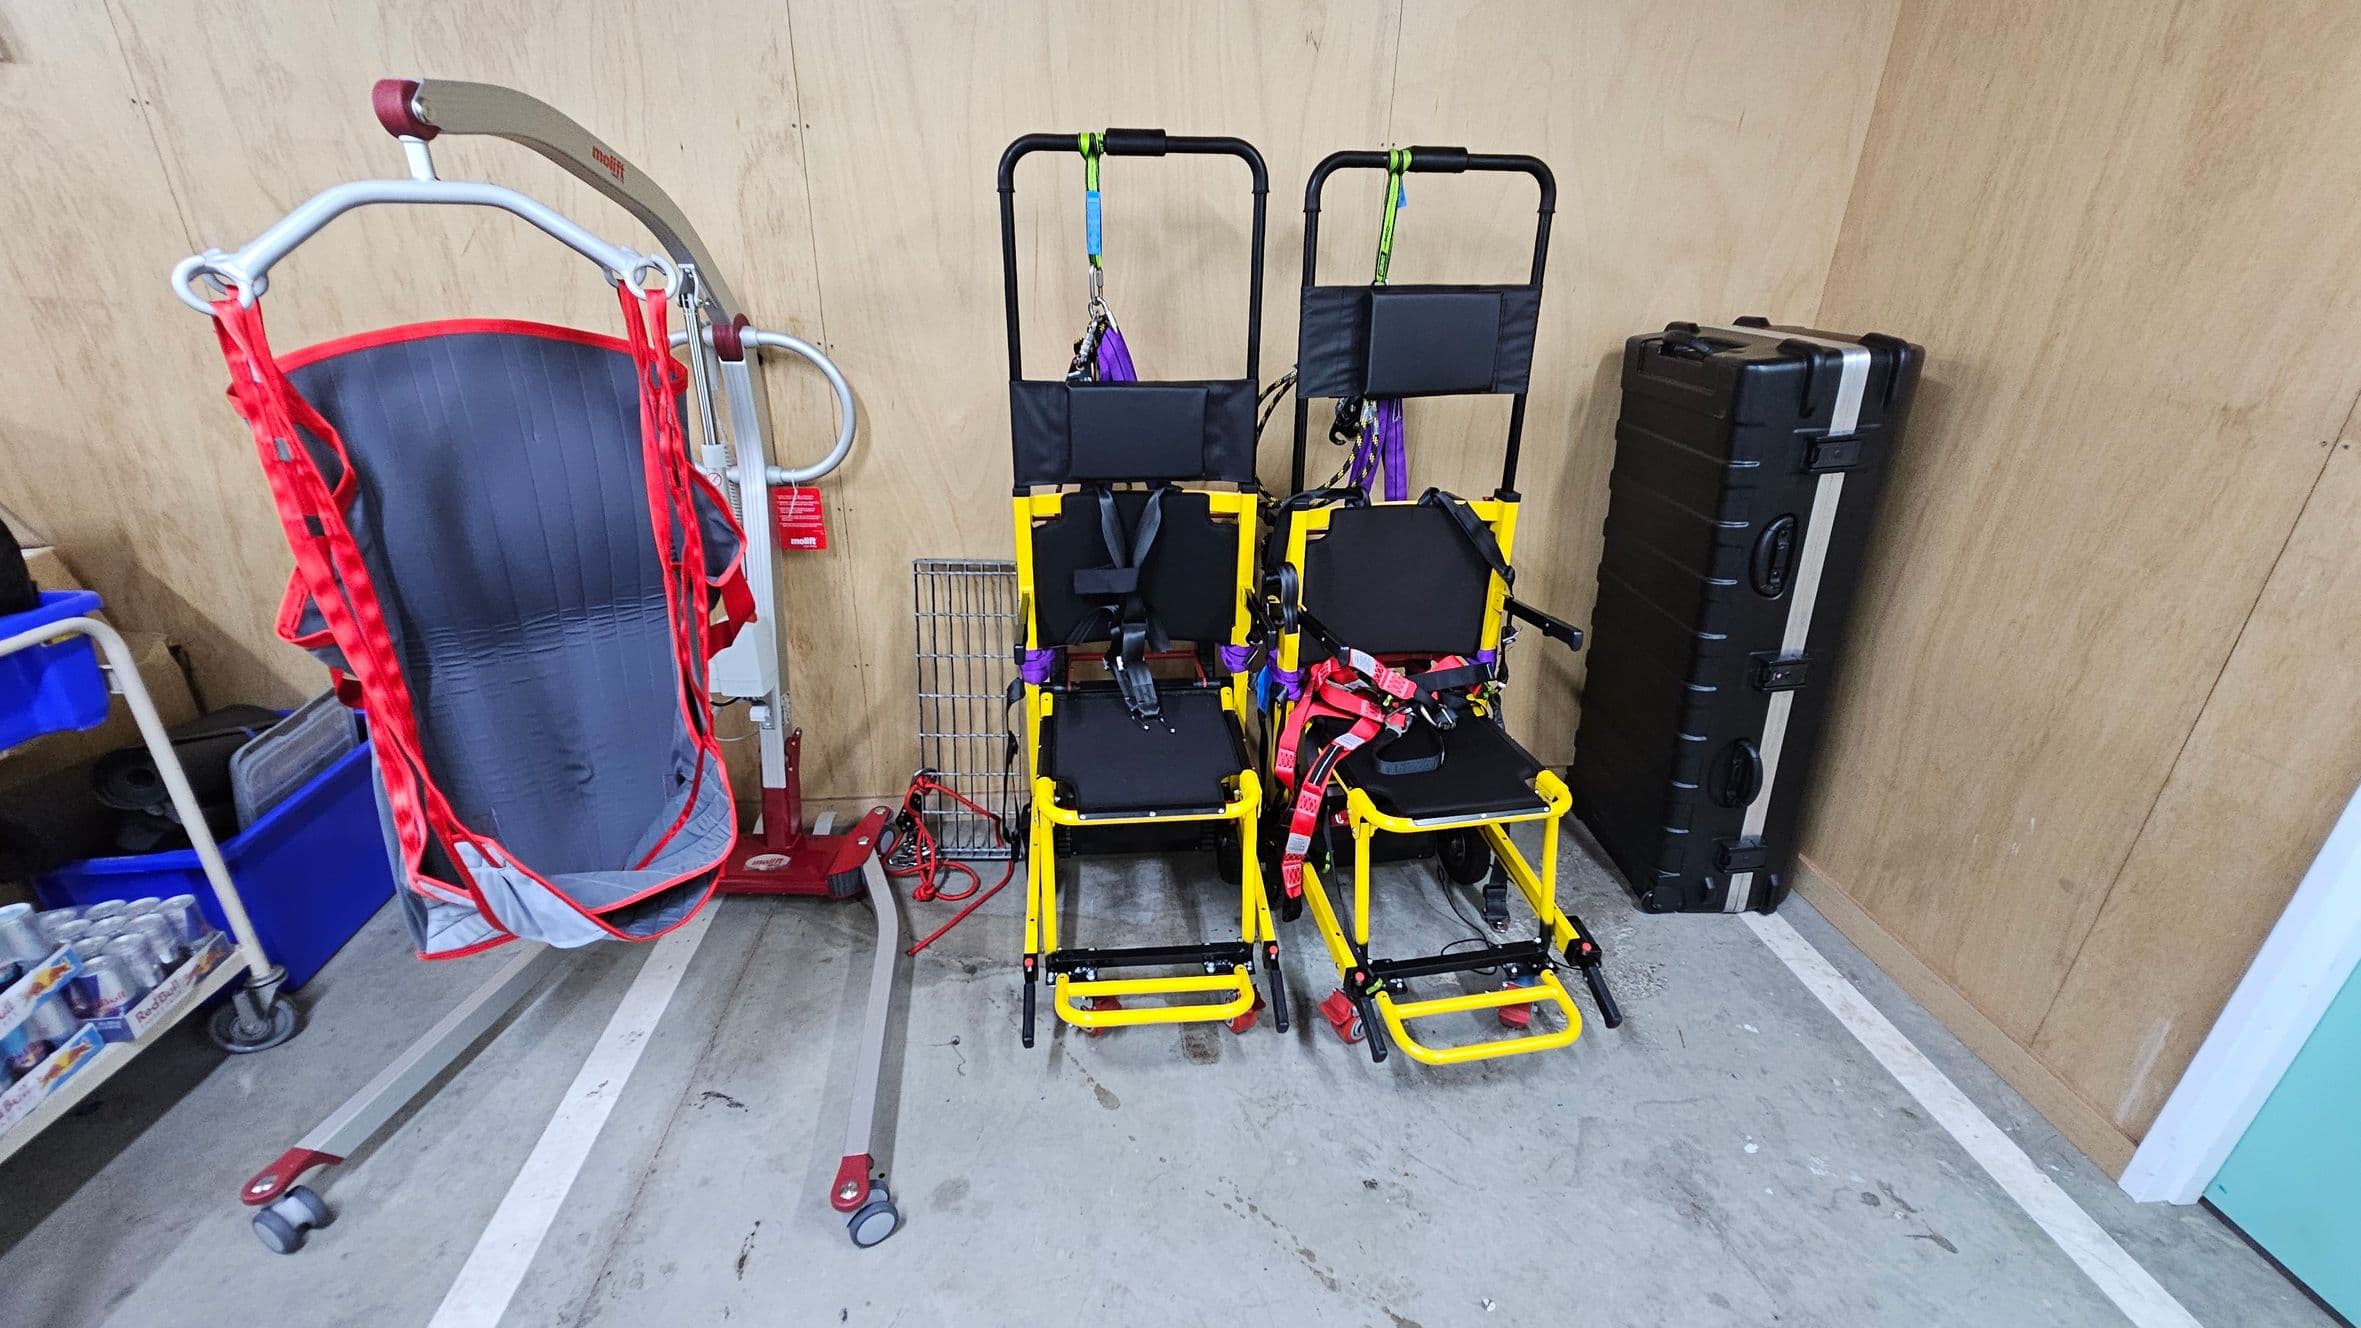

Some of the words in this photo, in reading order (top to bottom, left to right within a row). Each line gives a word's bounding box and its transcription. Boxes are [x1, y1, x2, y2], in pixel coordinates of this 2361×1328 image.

[592, 146, 624, 182] molift
[790, 537, 817, 546] molift
[136, 998, 158, 1022] Red
[157, 980, 179, 1003] Bull
